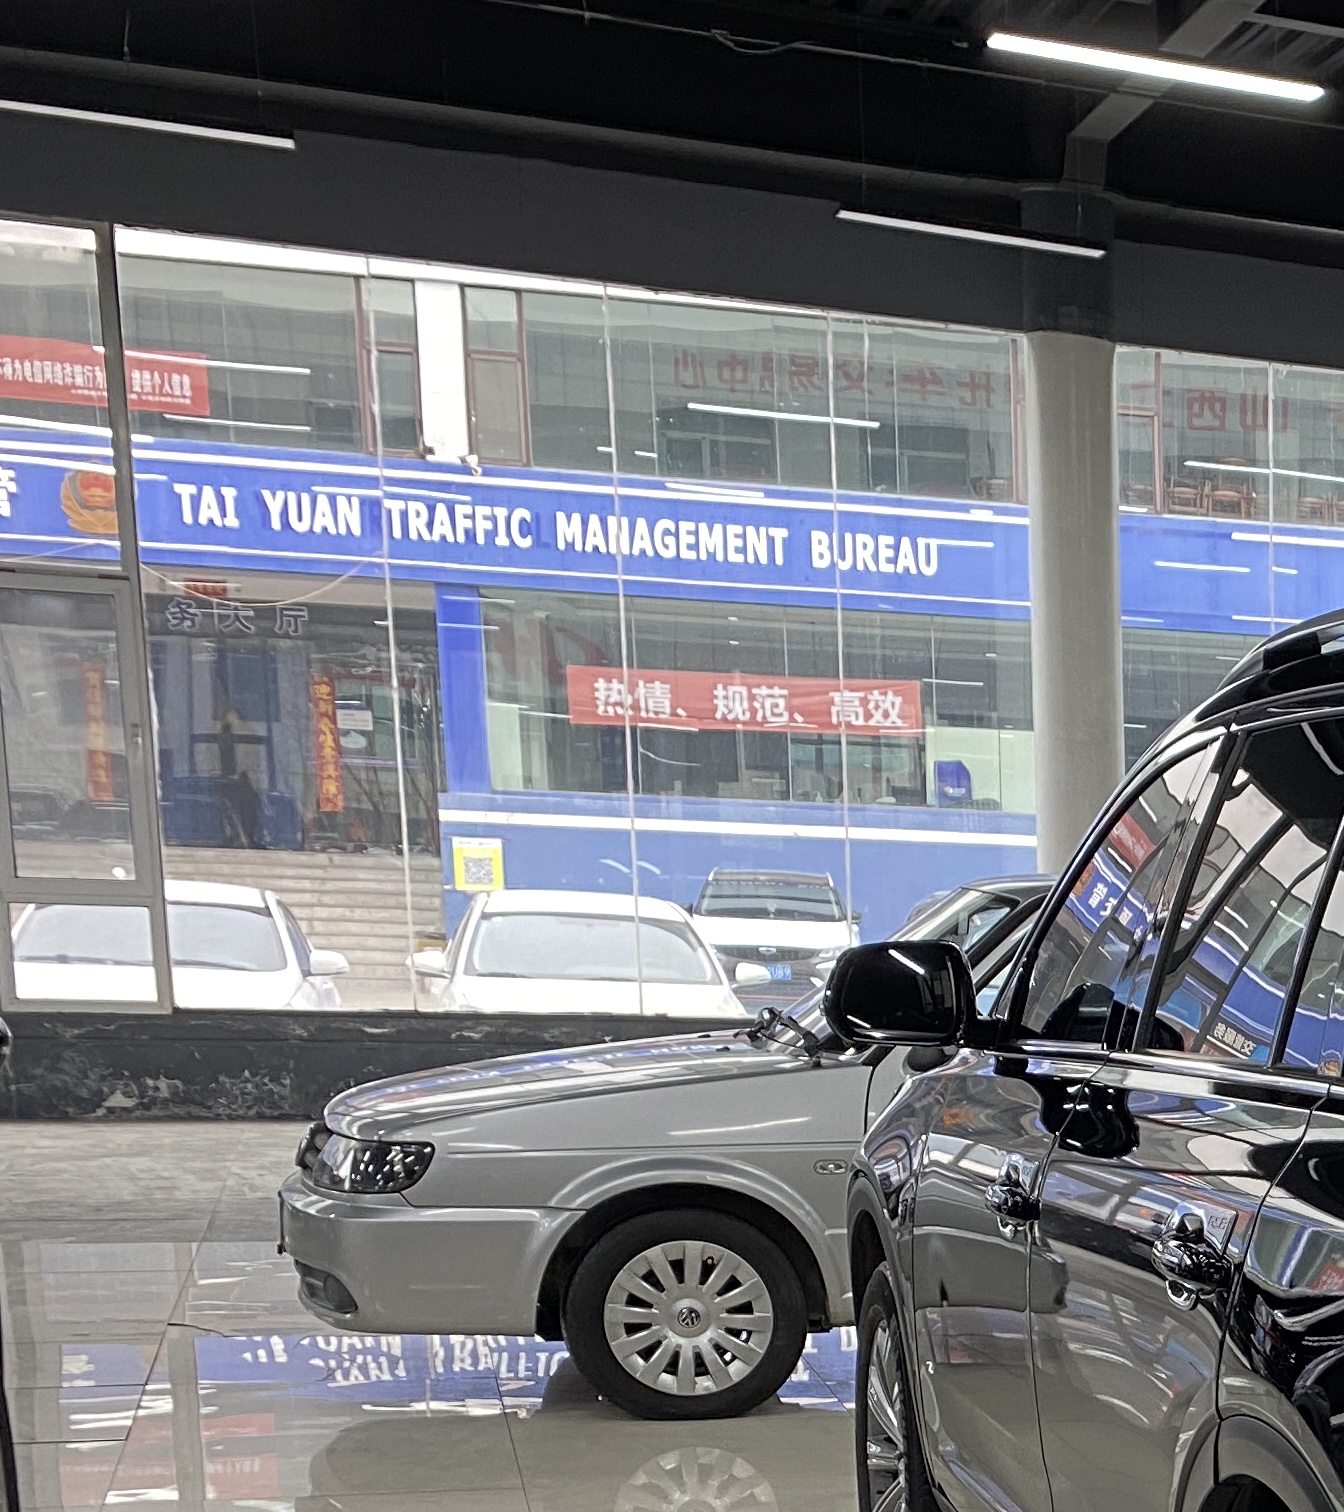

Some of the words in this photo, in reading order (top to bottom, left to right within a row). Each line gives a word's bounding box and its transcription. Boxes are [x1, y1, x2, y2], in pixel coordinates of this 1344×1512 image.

[174, 483, 240, 529] TAI
[261, 489, 362, 537] YUAN
[384, 499, 533, 549] TRAFFIC
[556, 511, 788, 568] MANAGEMENT
[811, 529, 939, 577] BUREAU
